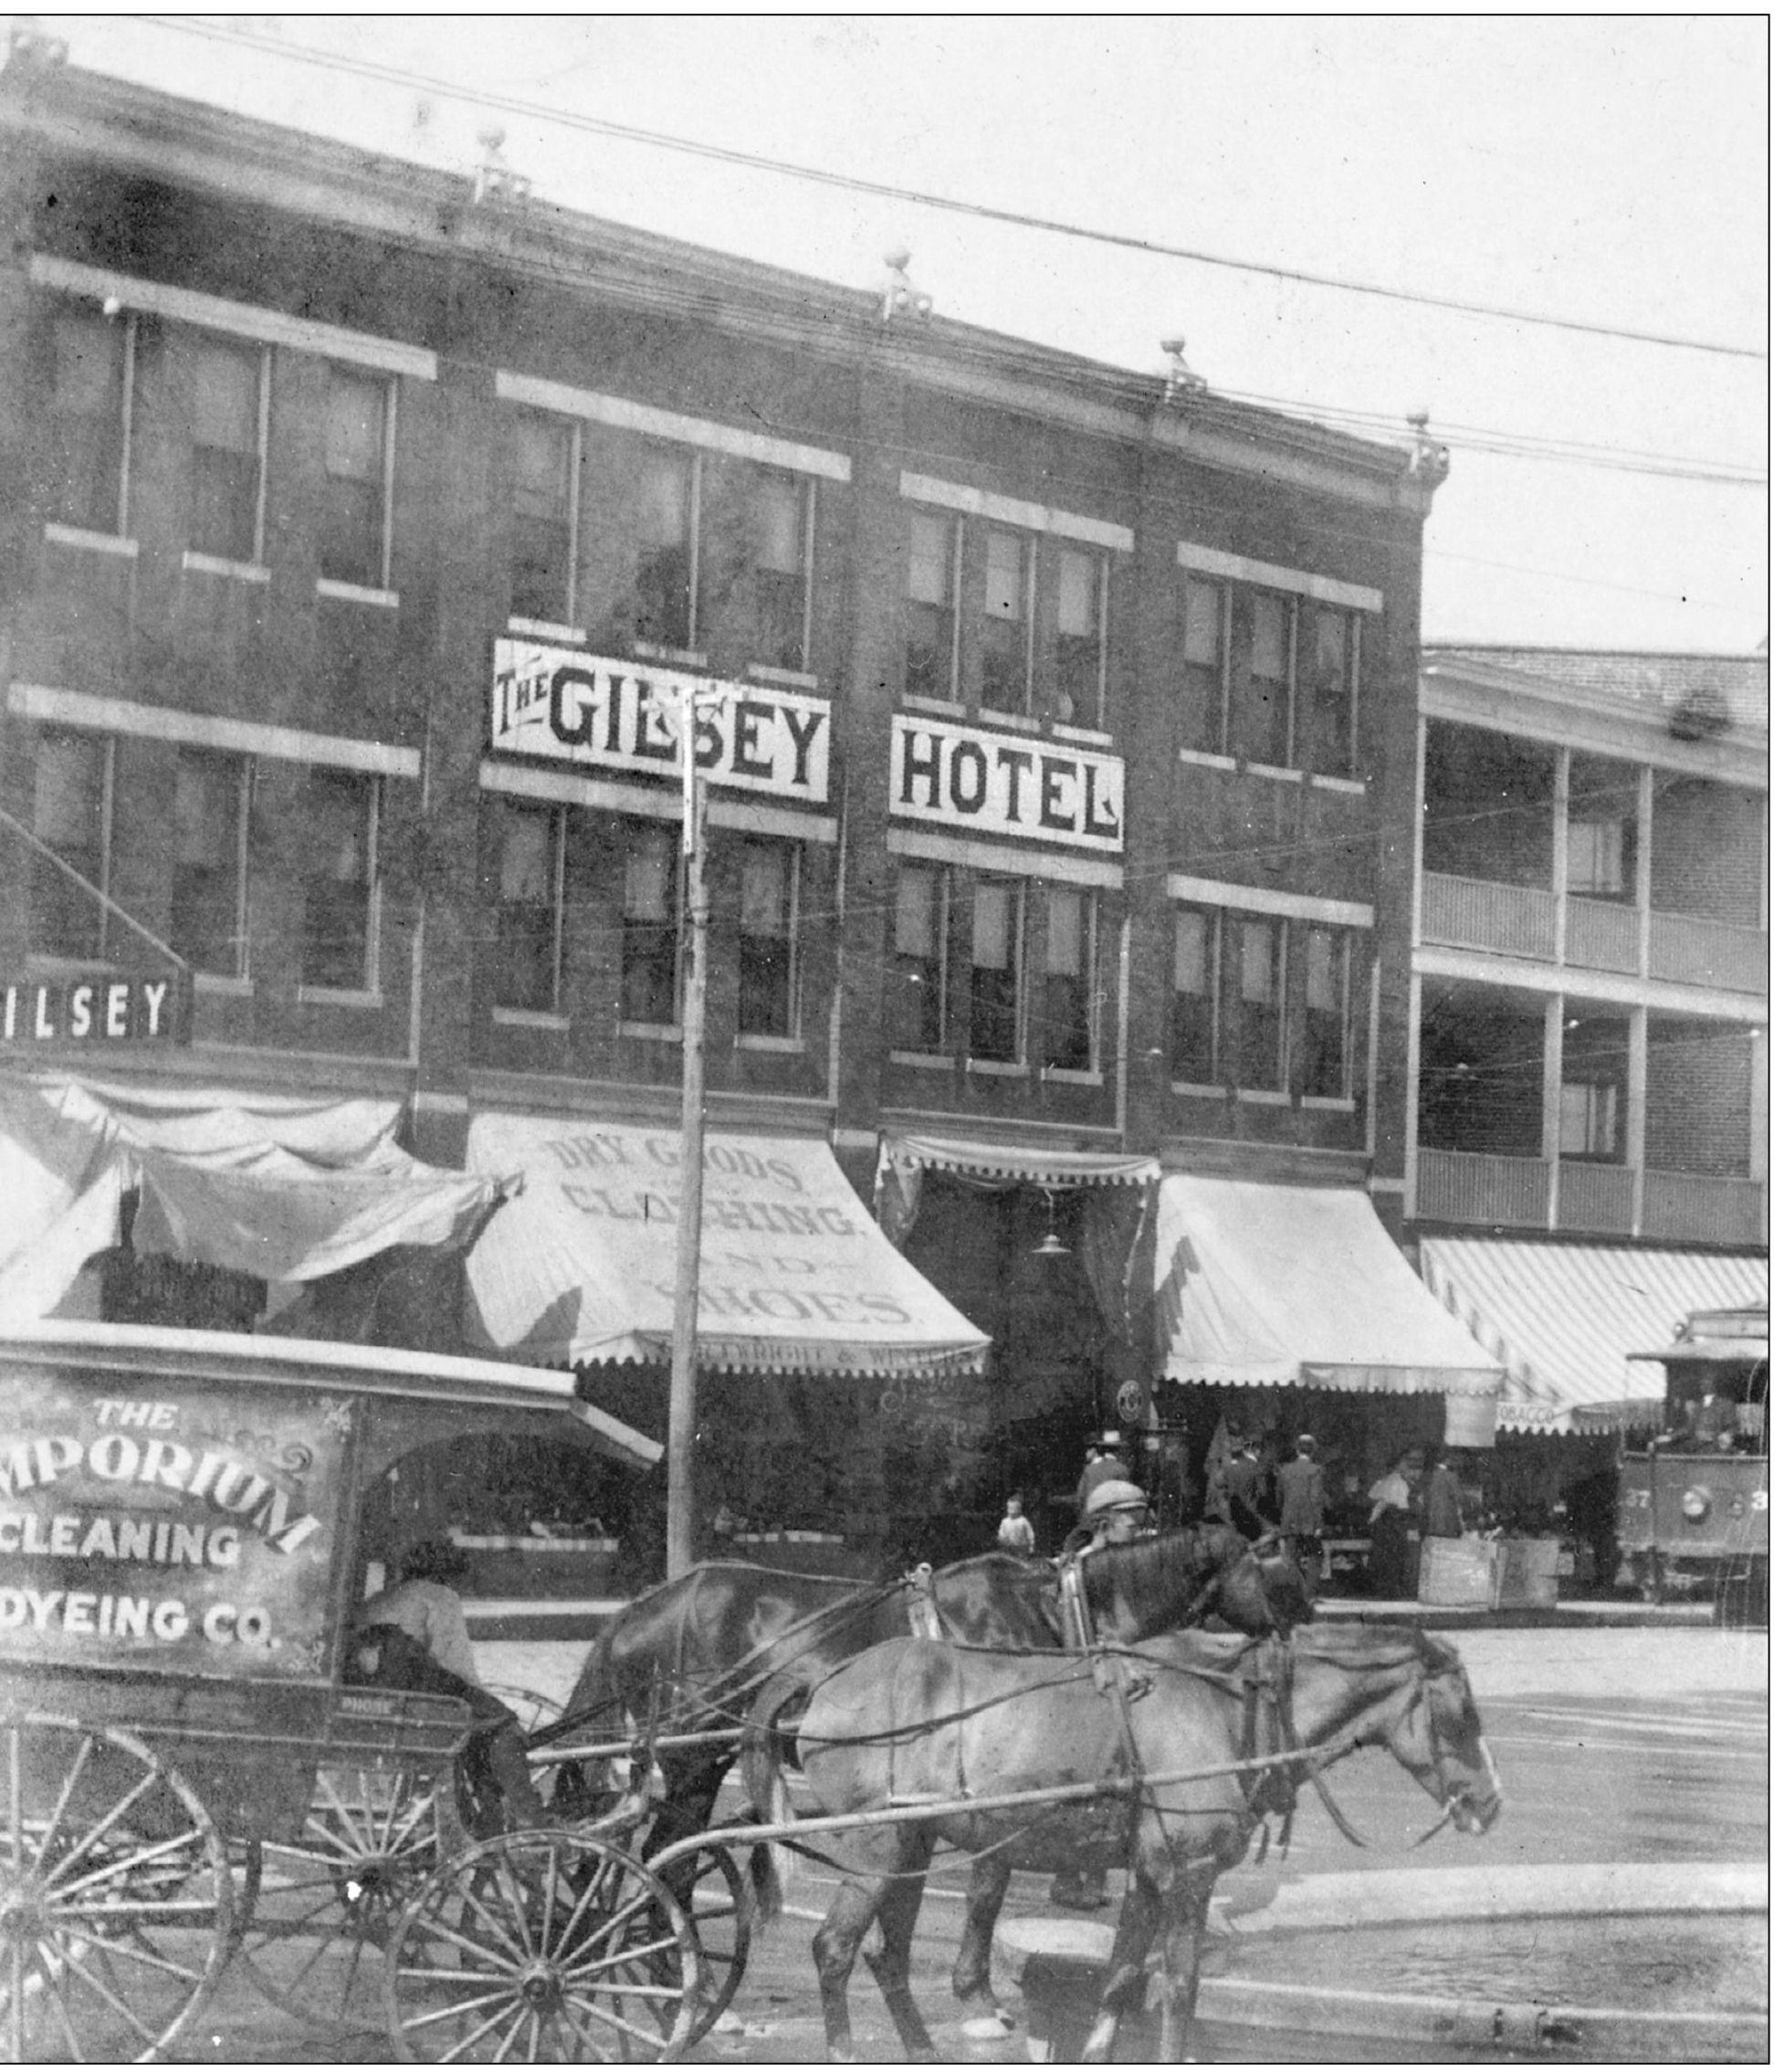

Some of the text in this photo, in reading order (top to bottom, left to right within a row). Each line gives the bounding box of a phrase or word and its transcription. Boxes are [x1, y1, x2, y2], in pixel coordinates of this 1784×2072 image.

[498, 666, 826, 785] THE GILSEY
[898, 729, 1119, 838] HOTEL
[5, 982, 167, 1040] ILSEY
[550, 1135, 633, 1169] DRY
[699, 1253, 816, 1275] ND
[94, 1399, 179, 1429] THE
[0, 1434, 320, 1553] MPORIUM
[0, 1511, 241, 1566] CLEANING
[0, 1585, 281, 1649] DYEING CO.
